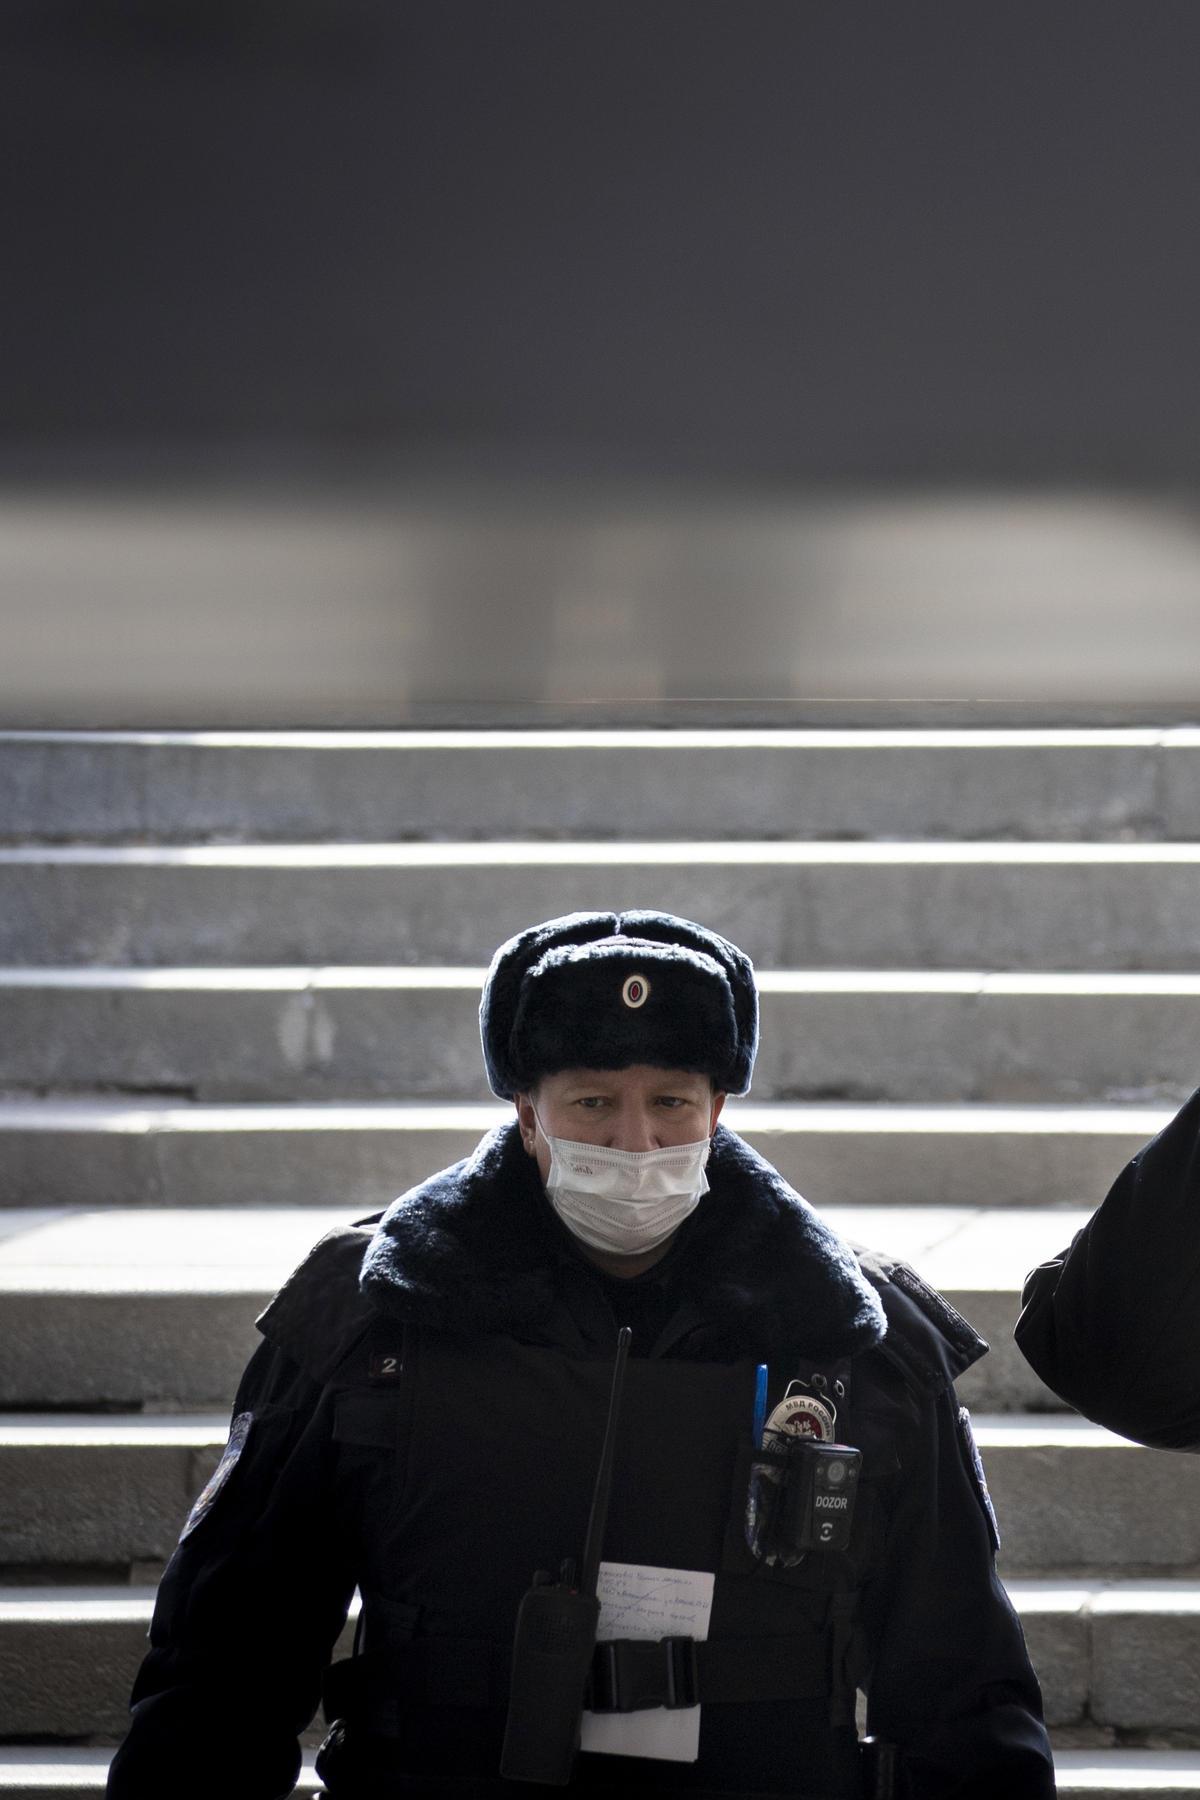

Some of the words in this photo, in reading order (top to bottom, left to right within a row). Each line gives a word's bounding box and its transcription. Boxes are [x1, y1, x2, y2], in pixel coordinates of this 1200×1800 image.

[785, 1400, 806, 1411] МВД
[807, 1402, 832, 1437] РОССИИ
[815, 1495, 848, 1510] DOZOR
